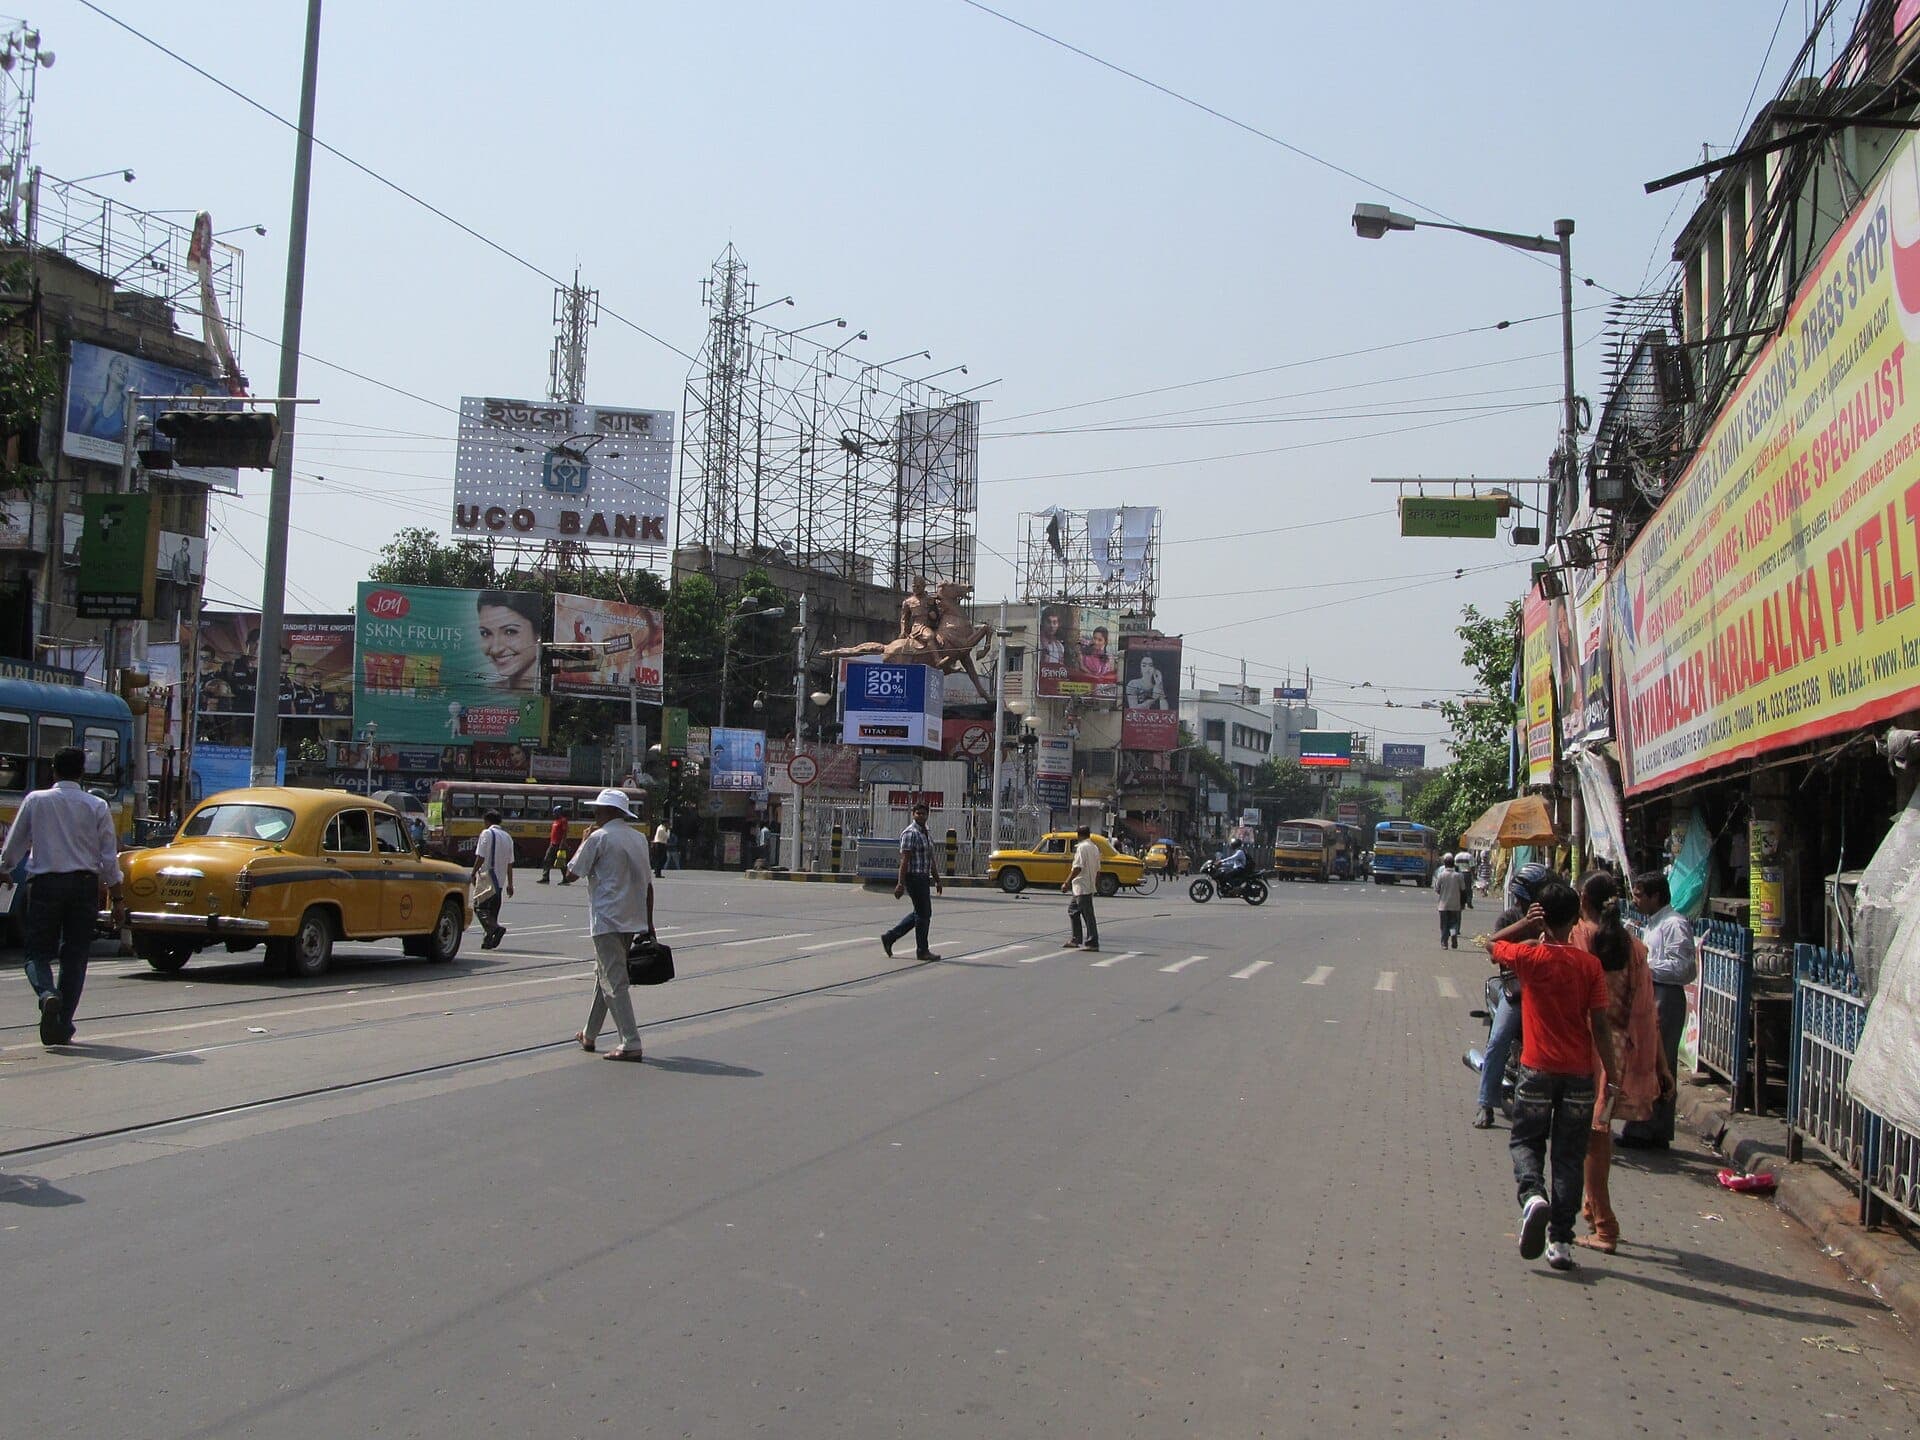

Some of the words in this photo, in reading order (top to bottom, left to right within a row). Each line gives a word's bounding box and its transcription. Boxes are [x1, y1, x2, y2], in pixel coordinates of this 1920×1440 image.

[1686, 458, 1712, 521] WINTER
[1717, 407, 1744, 478] RAINY
[1745, 336, 1797, 443] SEASON'S
[1800, 266, 1844, 374] DRESS
[1845, 199, 1888, 314] STOP
[1795, 404, 1804, 433] ALL
[1820, 374, 1827, 404] OF
[1827, 342, 1853, 394] UMBRELLA
[1859, 316, 1874, 356] RAIN
[1873, 295, 1889, 339] COAT
[1663, 583, 1684, 630] WARE
[1687, 552, 1713, 608] LADIES
[1712, 523, 1739, 583] WARE
[1744, 487, 1772, 554] KIDS
[1772, 447, 1812, 528] WARE
[1811, 342, 1905, 490] SPECIALIST
[457, 504, 536, 532] UCO
[559, 510, 665, 539] BANK
[282, 623, 308, 632] TANDING
[318, 624, 329, 632] THE
[330, 624, 355, 632] KNIGHTS
[365, 622, 402, 638] SKIN
[408, 625, 463, 641] FRUITS
[416, 641, 462, 651] WASH
[1630, 648, 1708, 747] SHYAMBAZAR
[1706, 558, 1828, 706] HARALALKA
[33, 668, 75, 687] HOTEL
[867, 670, 904, 683] 20+
[867, 682, 904, 695] 20%
[484, 706, 509, 714] missed
[1709, 713, 1732, 745] KOLKATA
[1756, 695, 1770, 727] PH.
[1769, 688, 1785, 722] 033
[1784, 679, 1802, 716] 2555
[1801, 671, 1821, 710] 9386
[1827, 661, 1846, 701] Web
[467, 714, 484, 723] 022
[486, 714, 507, 724] 3025
[334, 773, 383, 789] Gopal
